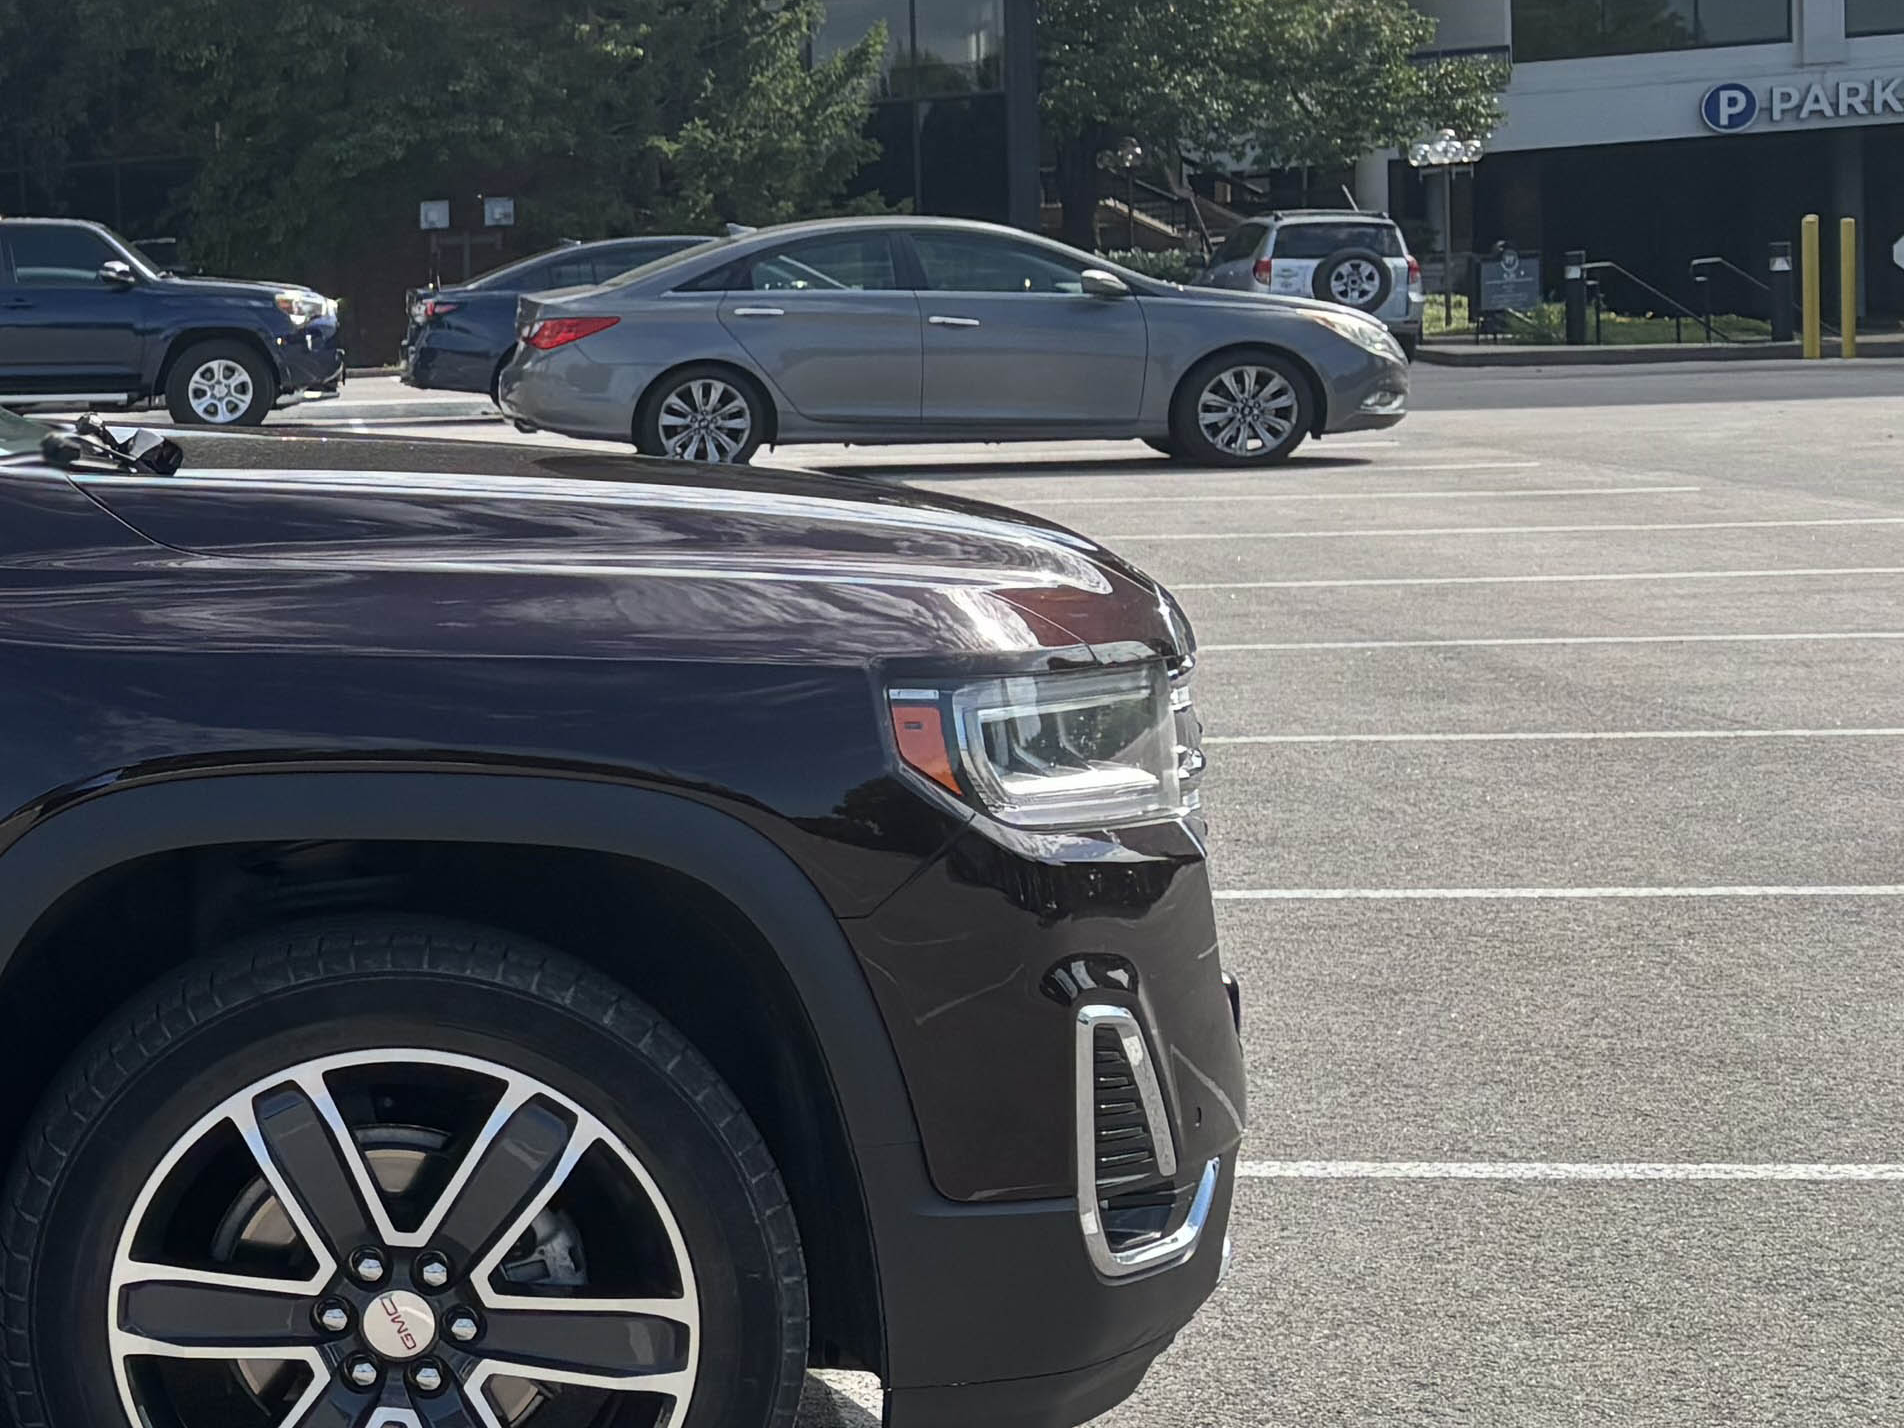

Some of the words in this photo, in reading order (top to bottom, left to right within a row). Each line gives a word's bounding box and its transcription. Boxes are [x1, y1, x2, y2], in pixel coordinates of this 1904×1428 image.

[1719, 90, 1746, 125] P
[1772, 78, 1904, 121] PARK
[380, 1293, 417, 1350] GMC
